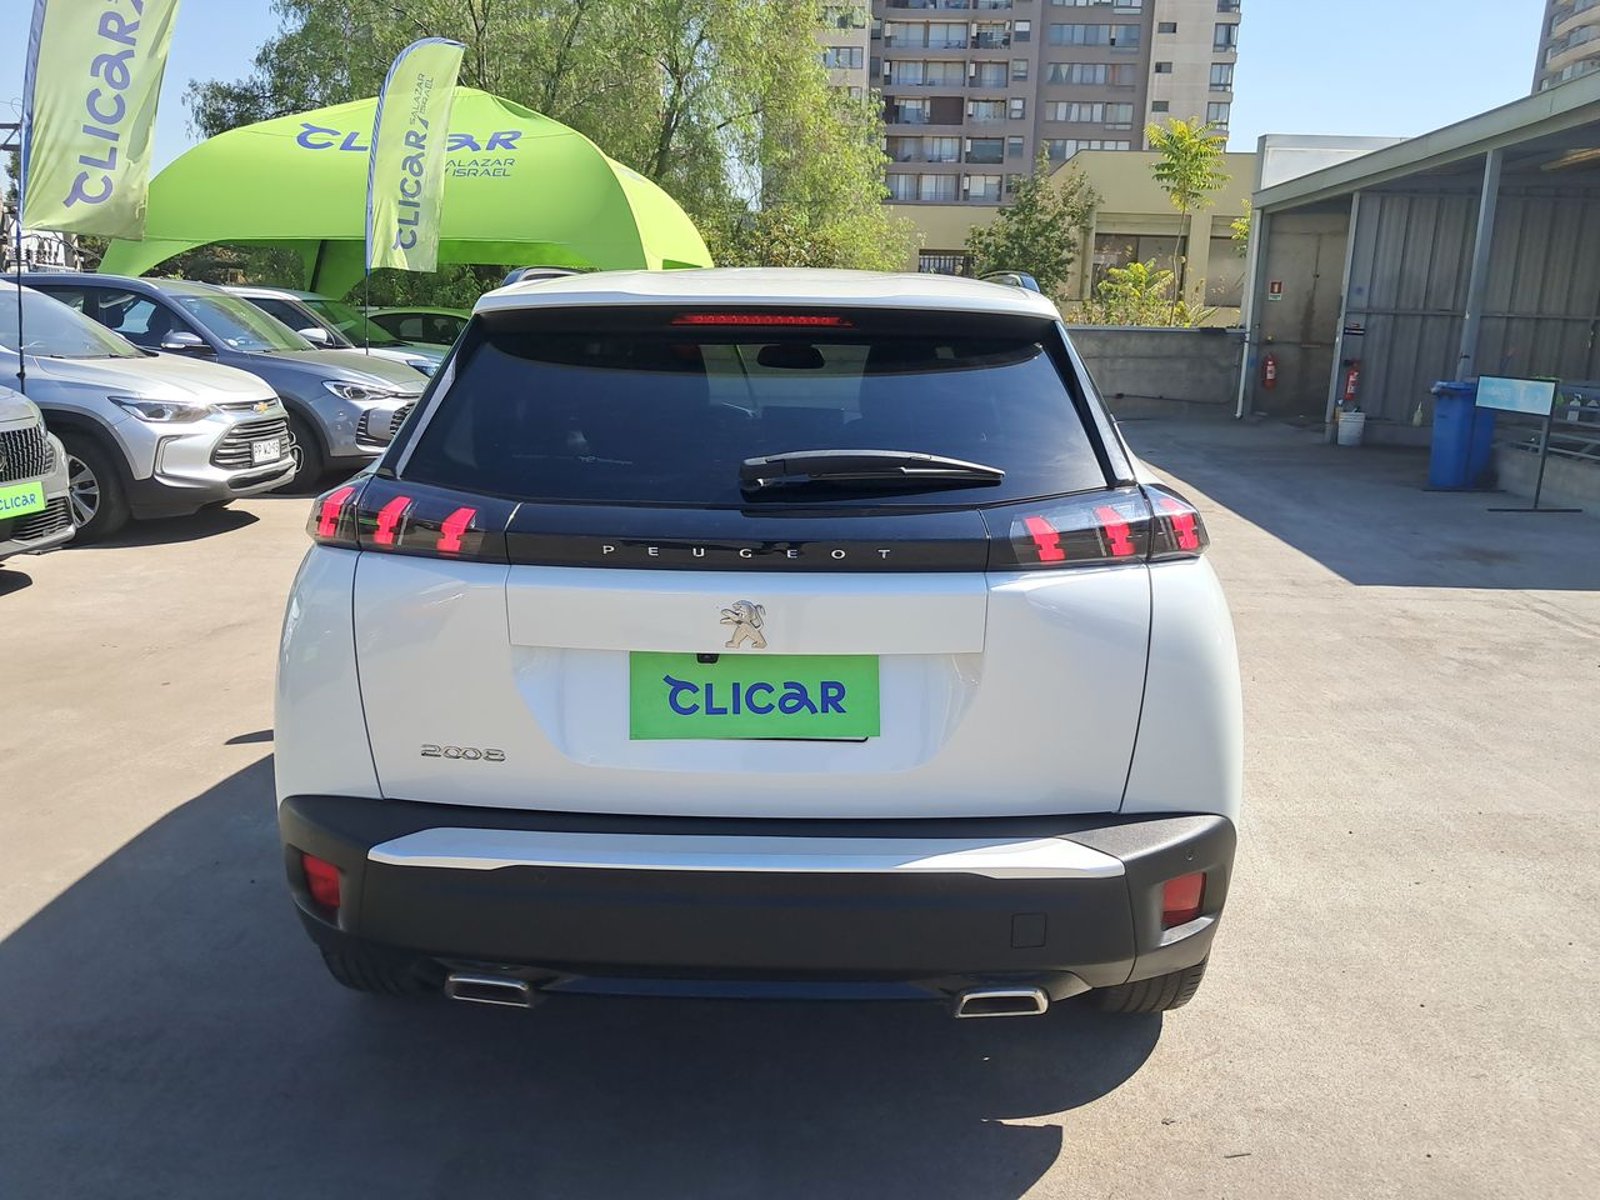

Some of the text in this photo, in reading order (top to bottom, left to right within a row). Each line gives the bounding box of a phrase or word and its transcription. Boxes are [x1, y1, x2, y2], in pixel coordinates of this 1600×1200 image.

[409, 73, 425, 125] SALAZAR
[420, 78, 434, 114] ISRAEL
[296, 122, 522, 152] CLaR
[446, 158, 516, 167] ALAZAR
[452, 168, 511, 177] ISRAEL
[602, 544, 891, 560] PEUGEOT
[420, 744, 506, 762] 2008
